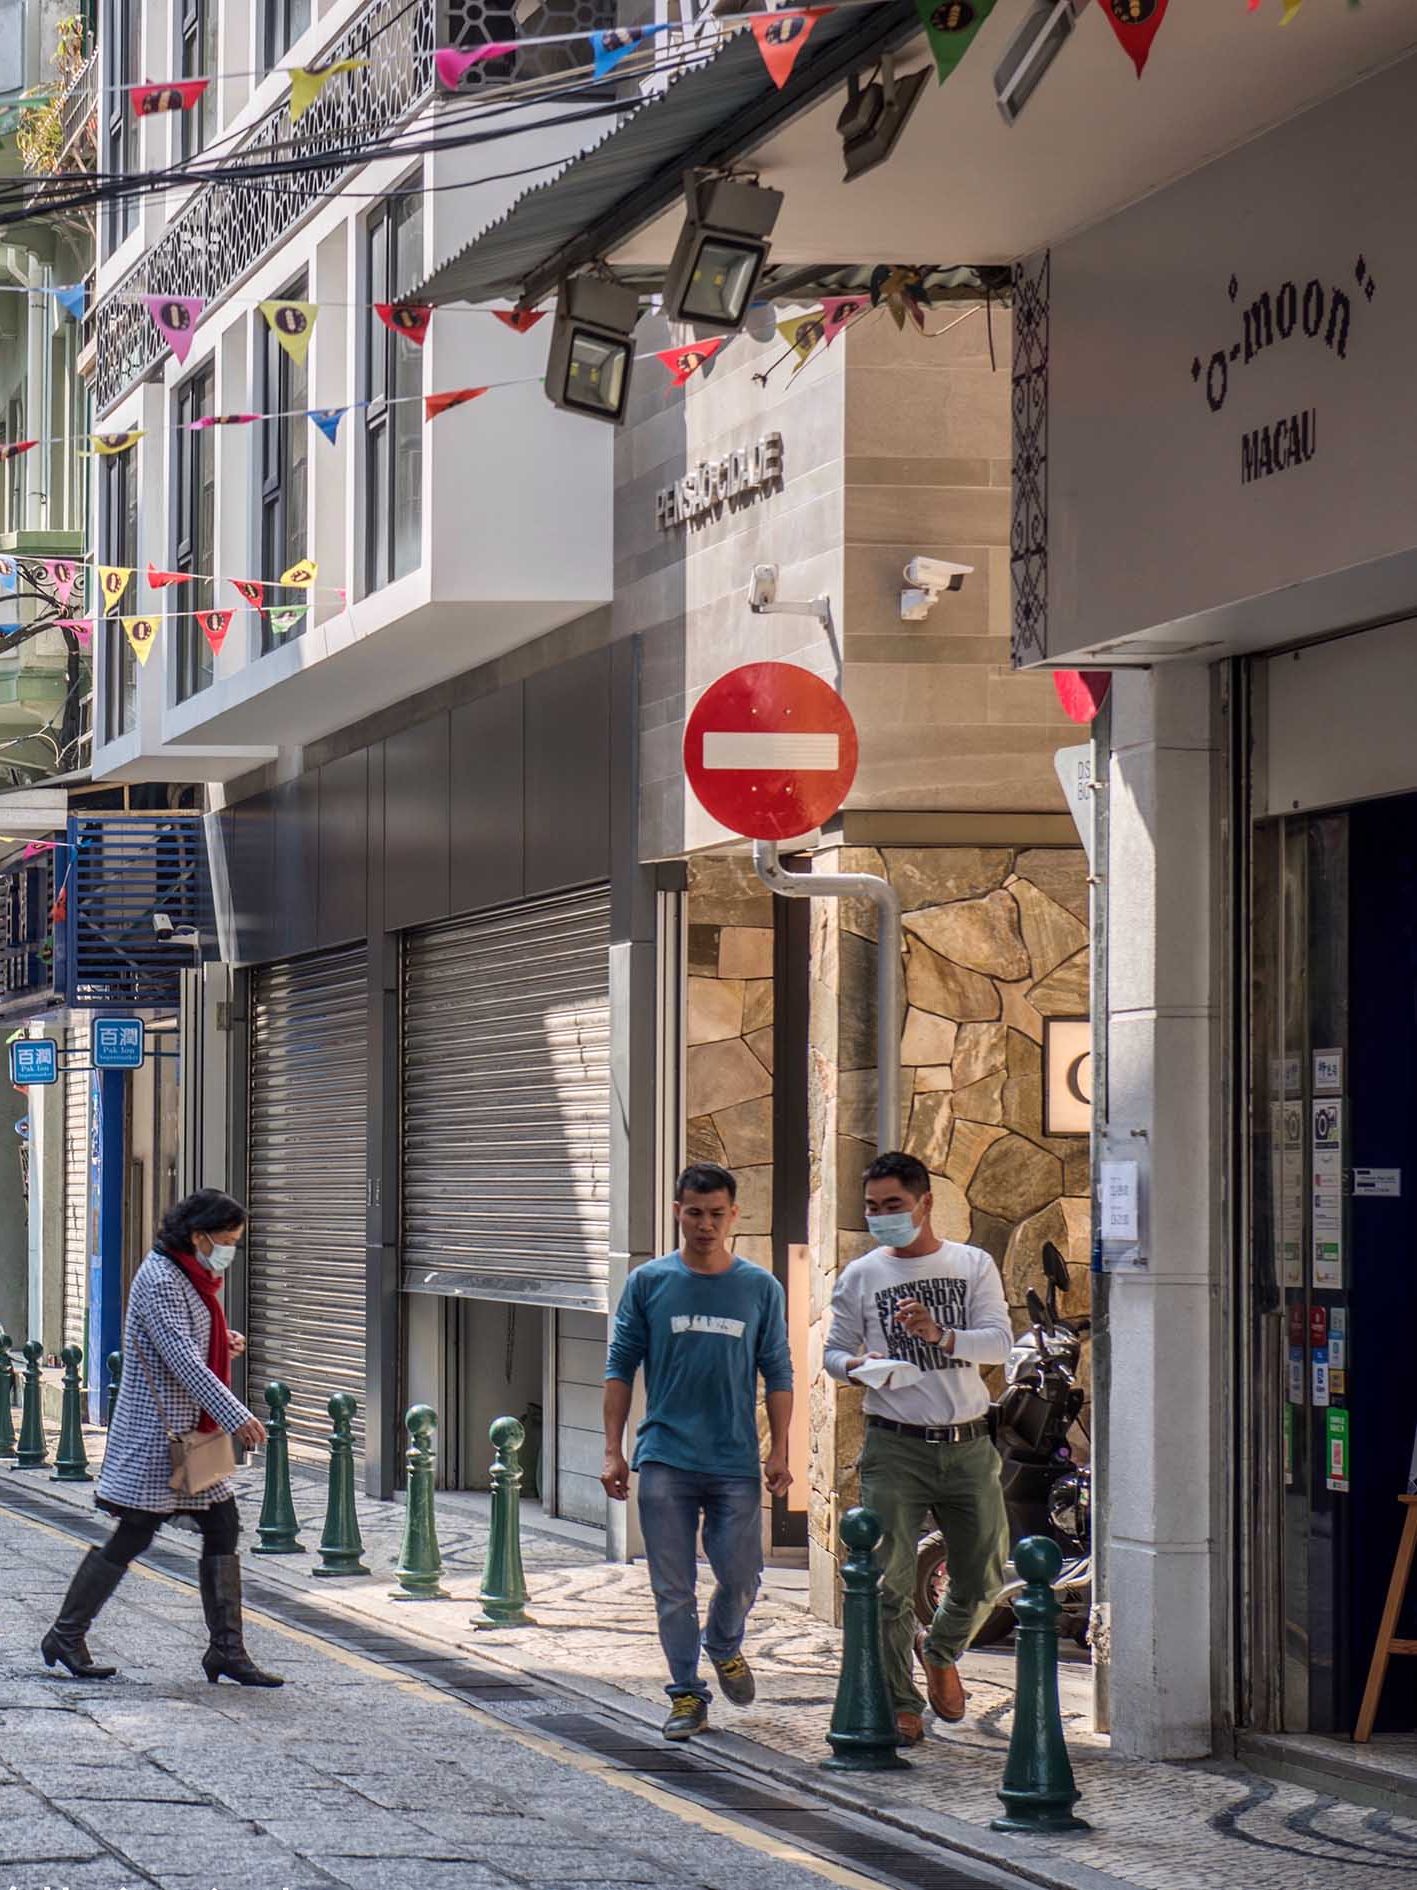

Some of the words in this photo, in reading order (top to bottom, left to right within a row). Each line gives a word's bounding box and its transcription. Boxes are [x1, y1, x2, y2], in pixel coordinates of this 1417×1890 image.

[717, 431, 782, 502] CIDADE
[1241, 407, 1316, 475] MACAU
[917, 1277, 967, 1291] CLOTHES
